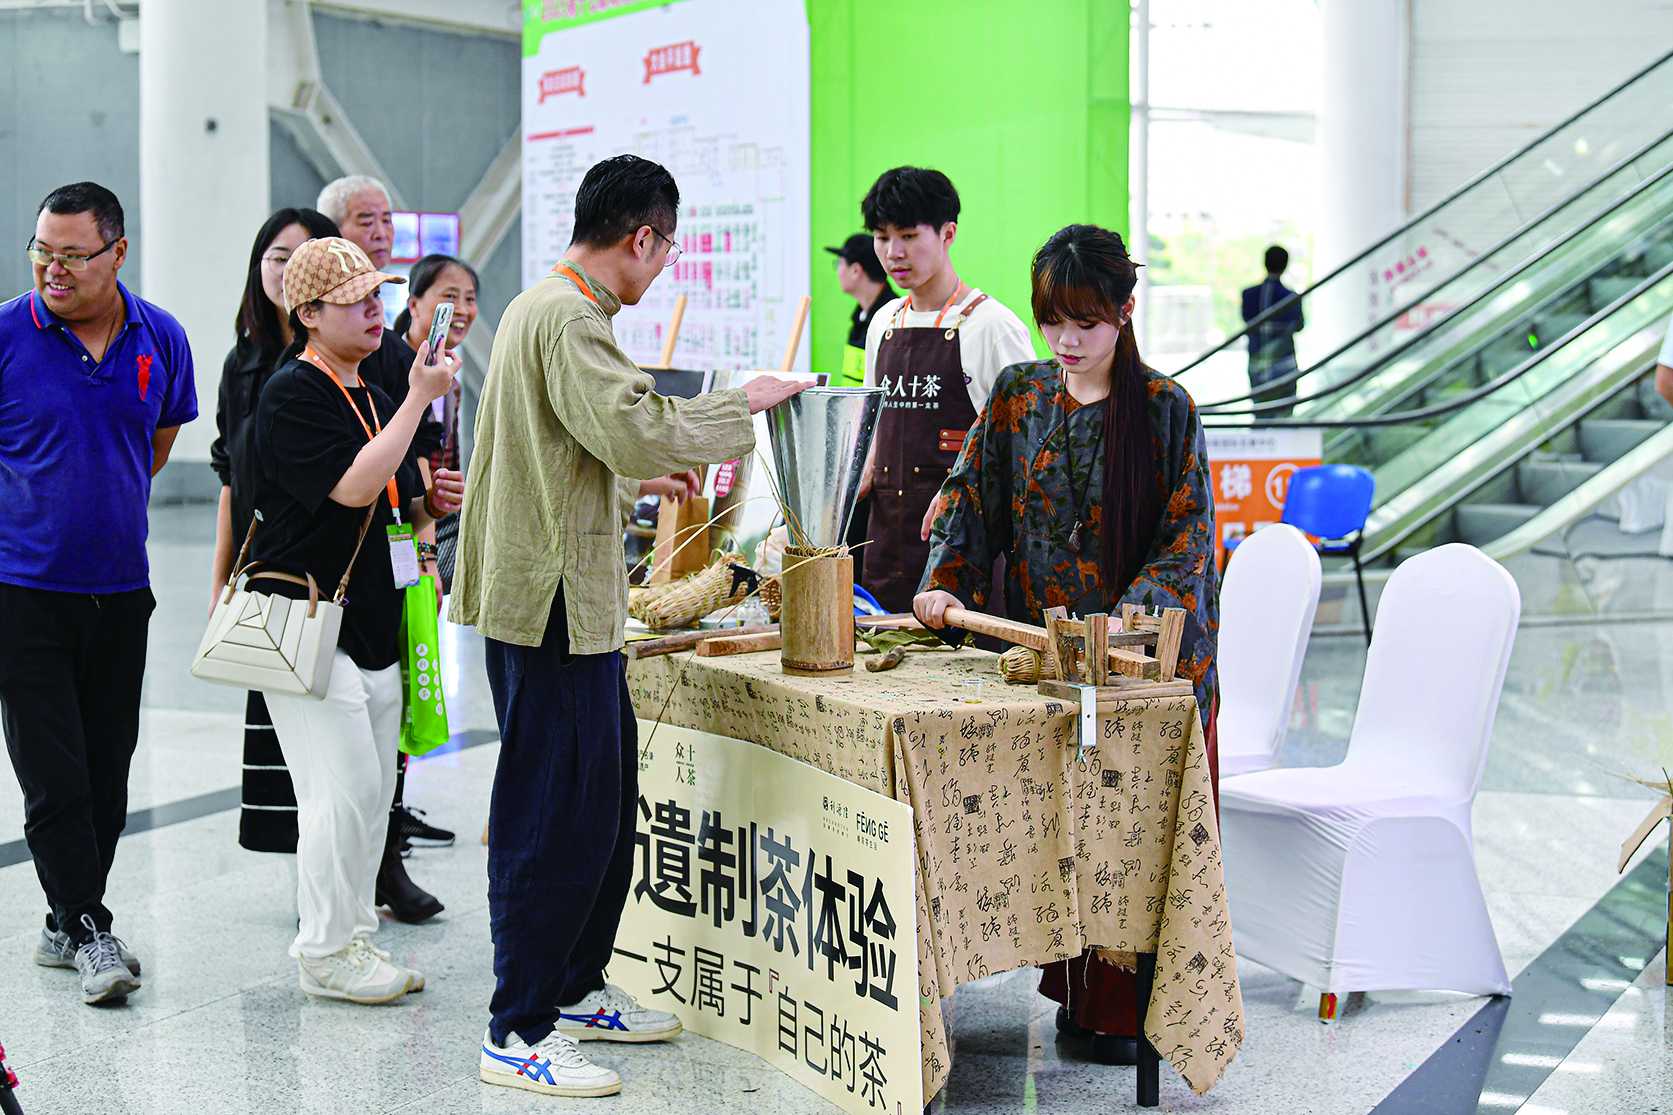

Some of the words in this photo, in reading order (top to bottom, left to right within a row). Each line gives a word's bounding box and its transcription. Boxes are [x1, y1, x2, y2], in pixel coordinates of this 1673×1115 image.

[879, 374, 942, 398] 众人十茶
[1220, 463, 1253, 500] 梯
